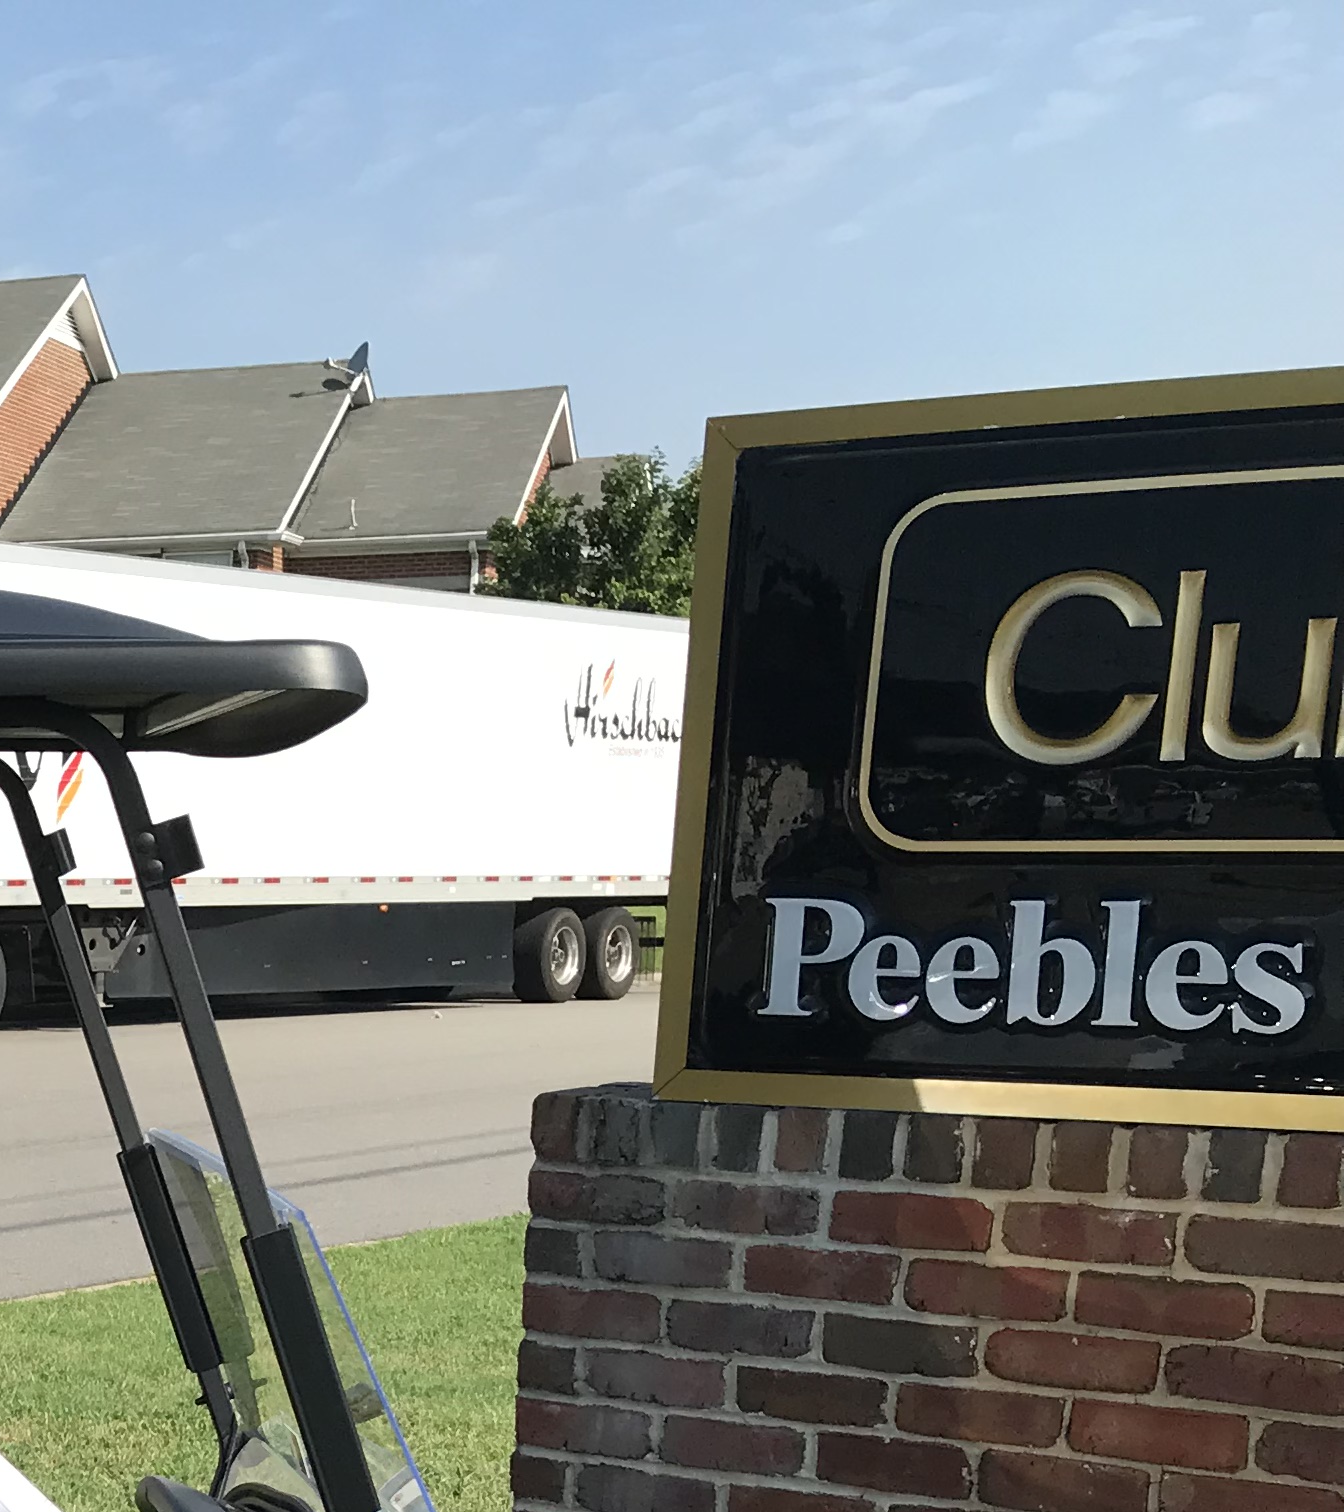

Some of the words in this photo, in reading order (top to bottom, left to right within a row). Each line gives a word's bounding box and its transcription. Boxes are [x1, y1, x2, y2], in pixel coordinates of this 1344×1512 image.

[564, 662, 683, 748] Hirschbac
[984, 568, 1344, 766] Clu
[756, 896, 1307, 1035] Peebles
